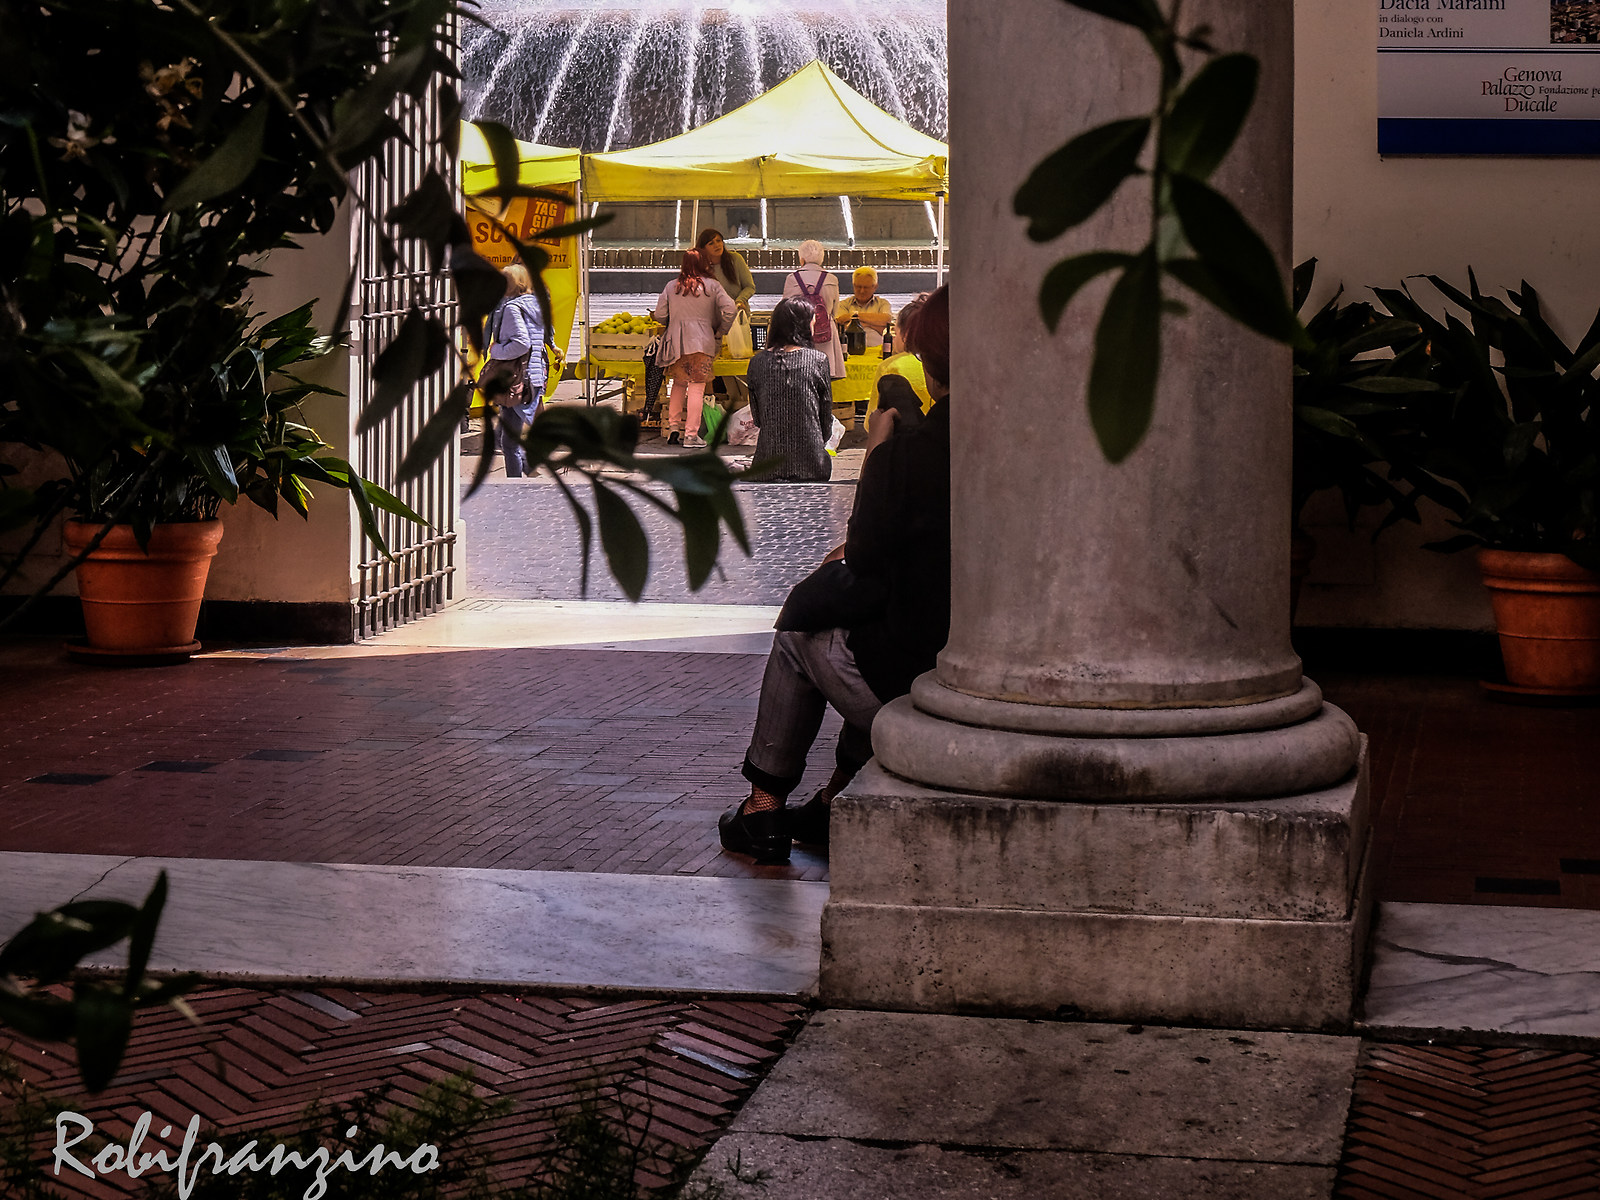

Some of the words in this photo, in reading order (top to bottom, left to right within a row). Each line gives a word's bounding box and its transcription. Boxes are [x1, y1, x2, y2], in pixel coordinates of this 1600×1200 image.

[1379, 15, 1388, 23] in
[1390, 14, 1425, 25] dialogo
[1426, 15, 1444, 23] con
[1379, 27, 1424, 38] Daniela
[1427, 27, 1464, 39] Ardini
[1504, 66, 1562, 82] Genova
[1481, 79, 1535, 100] Palazzo
[1539, 85, 1589, 95] Fondazione
[1505, 95, 1558, 112] Ducale
[535, 200, 558, 216] TAG
